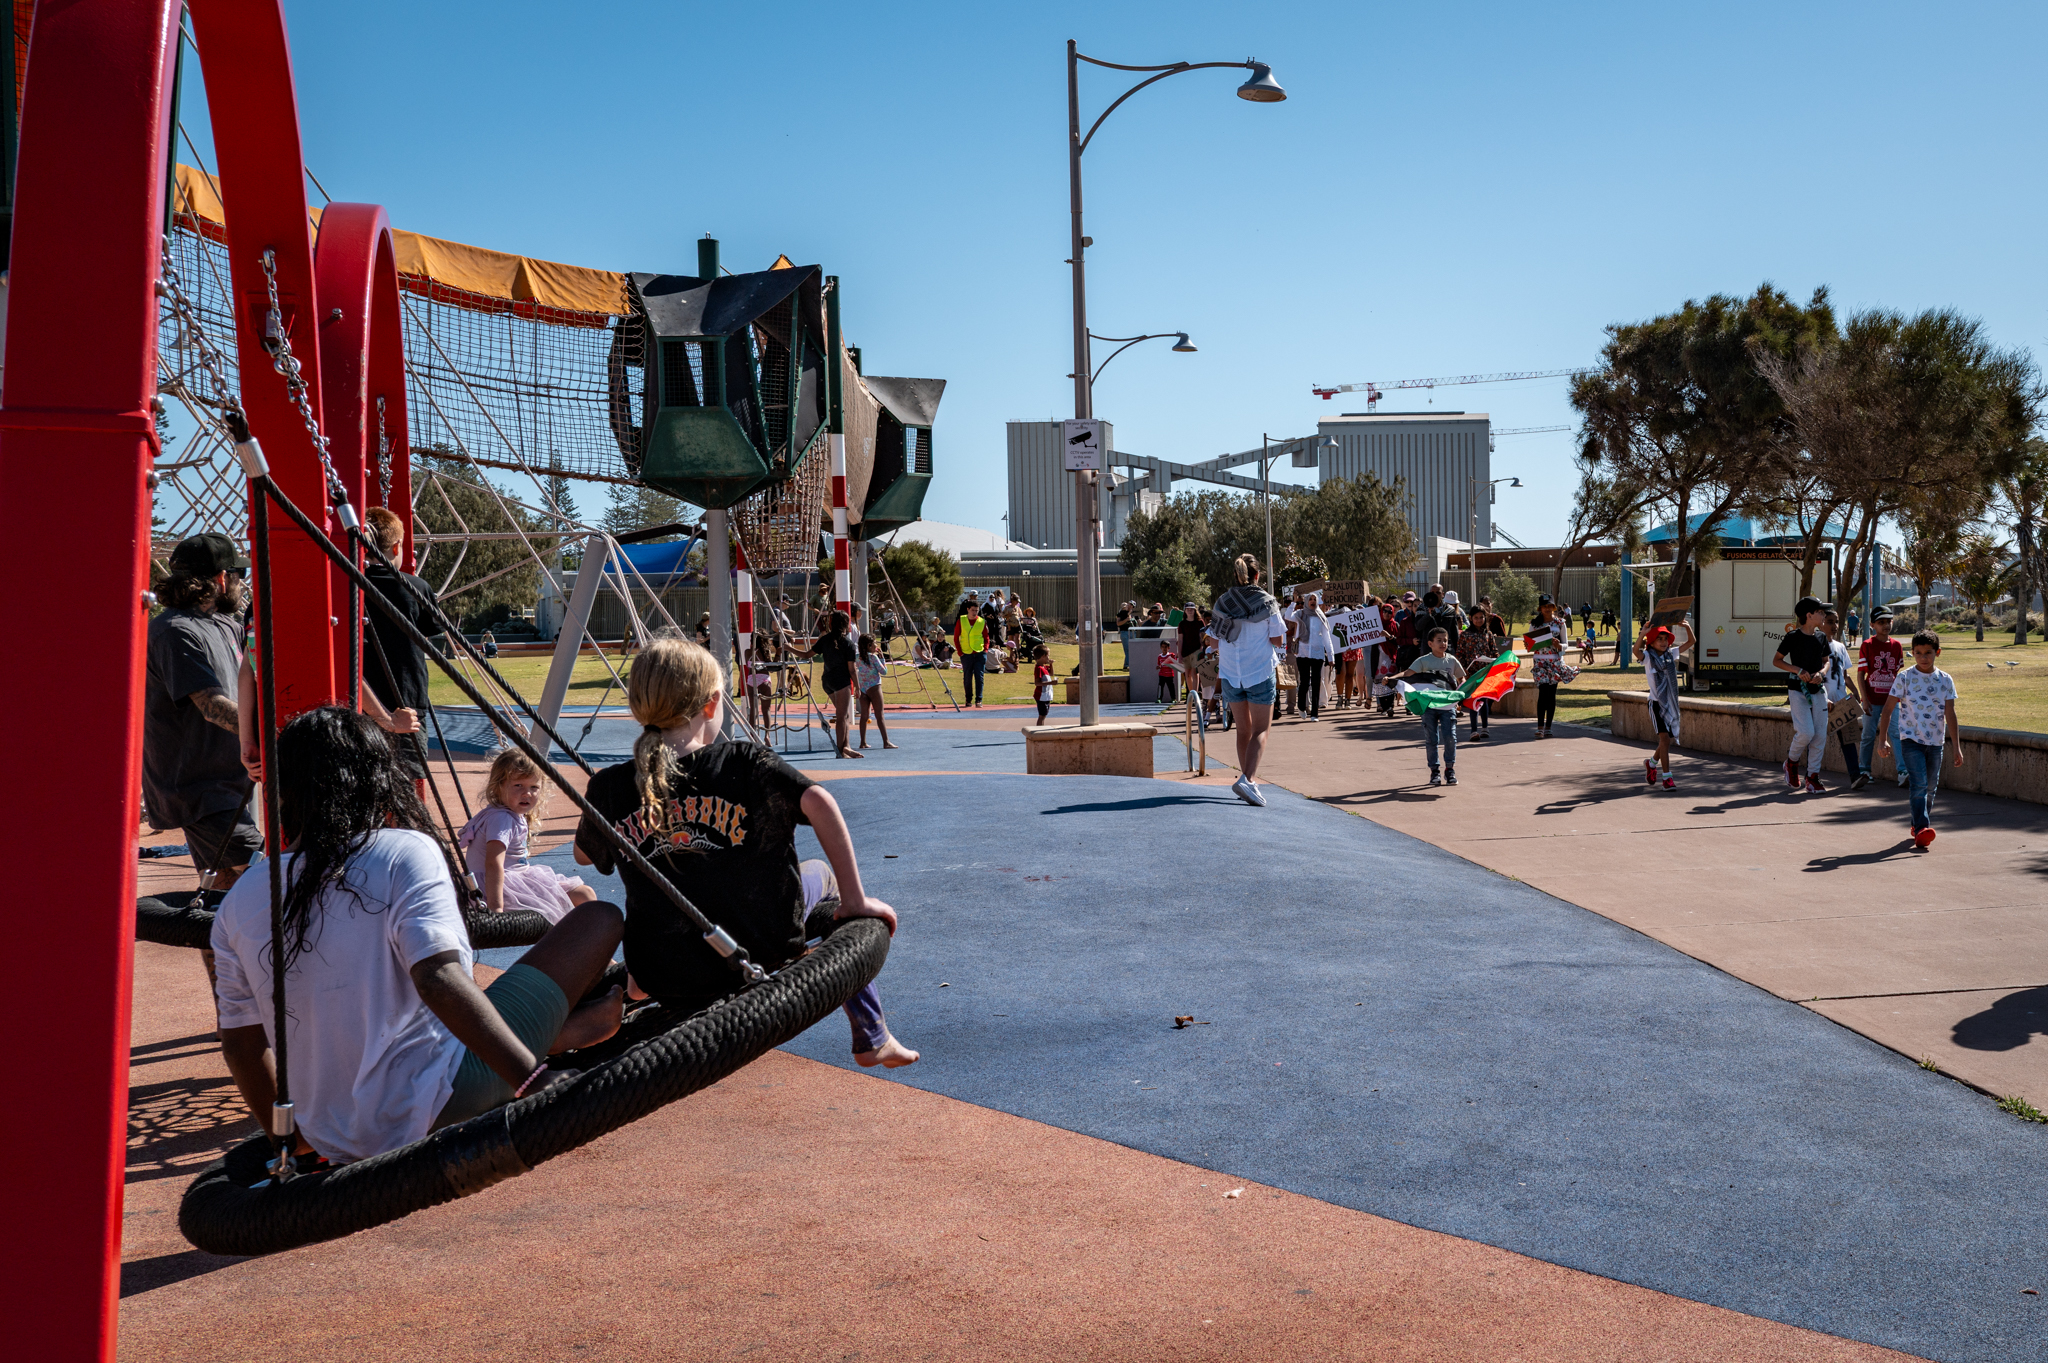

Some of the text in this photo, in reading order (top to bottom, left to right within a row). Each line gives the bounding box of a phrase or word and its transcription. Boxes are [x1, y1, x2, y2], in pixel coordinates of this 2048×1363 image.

[1324, 595, 1360, 604] GENOCIDE
[1348, 612, 1365, 623] END
[1349, 618, 1379, 634] ISRAELI
[1349, 630, 1381, 646] APARTHEID
